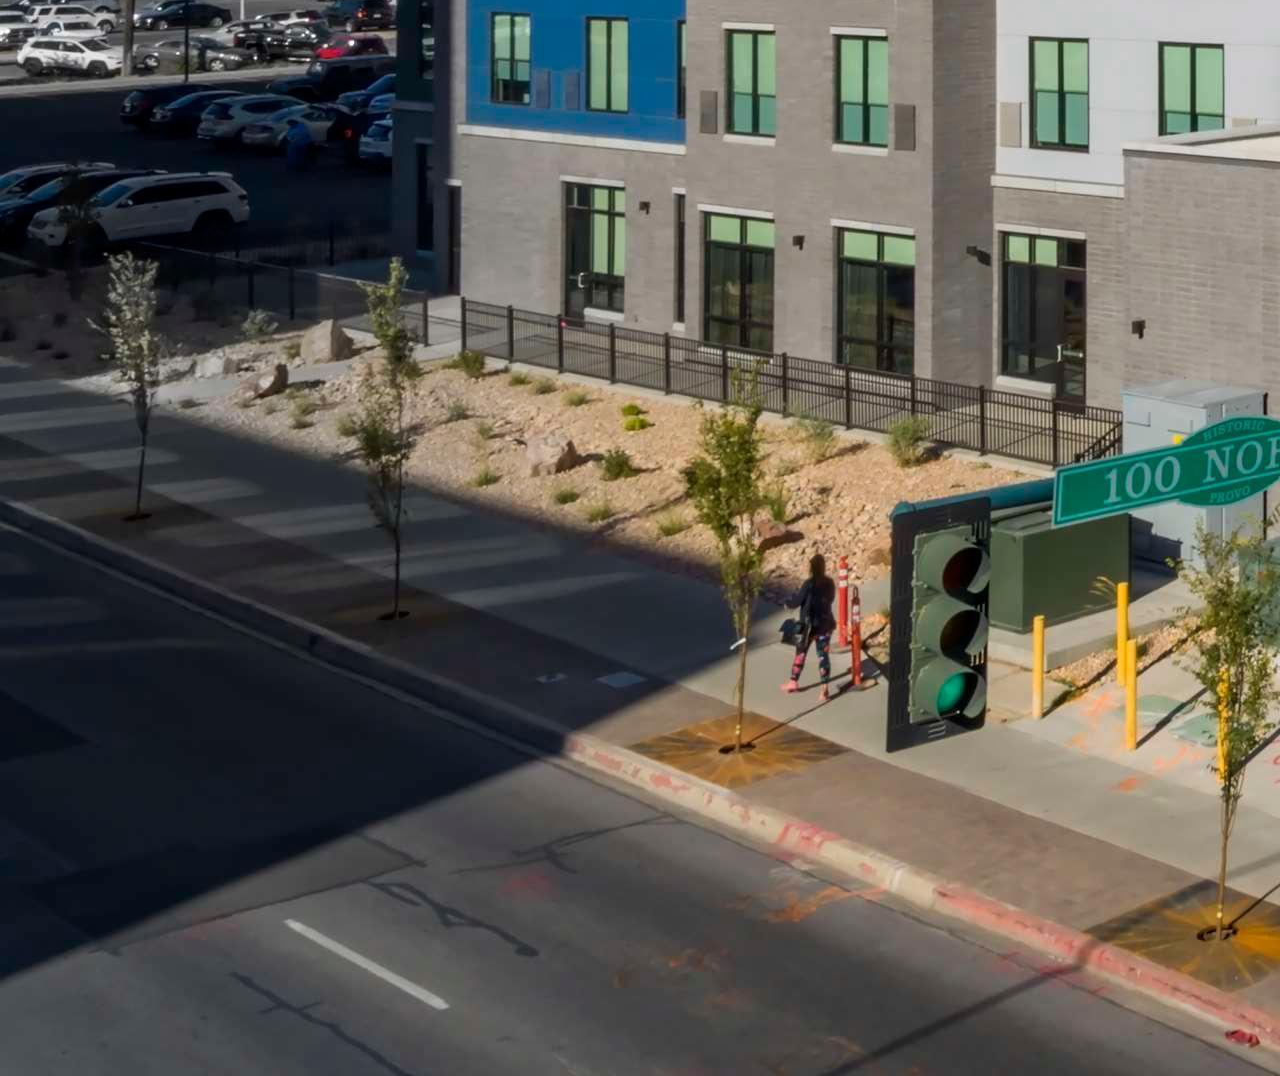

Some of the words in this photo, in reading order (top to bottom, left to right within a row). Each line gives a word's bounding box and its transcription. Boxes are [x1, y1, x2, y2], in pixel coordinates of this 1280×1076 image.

[1203, 419, 1265, 441] HISTORIC
[1103, 455, 1181, 504] 100
[1209, 485, 1250, 504] PROVO
